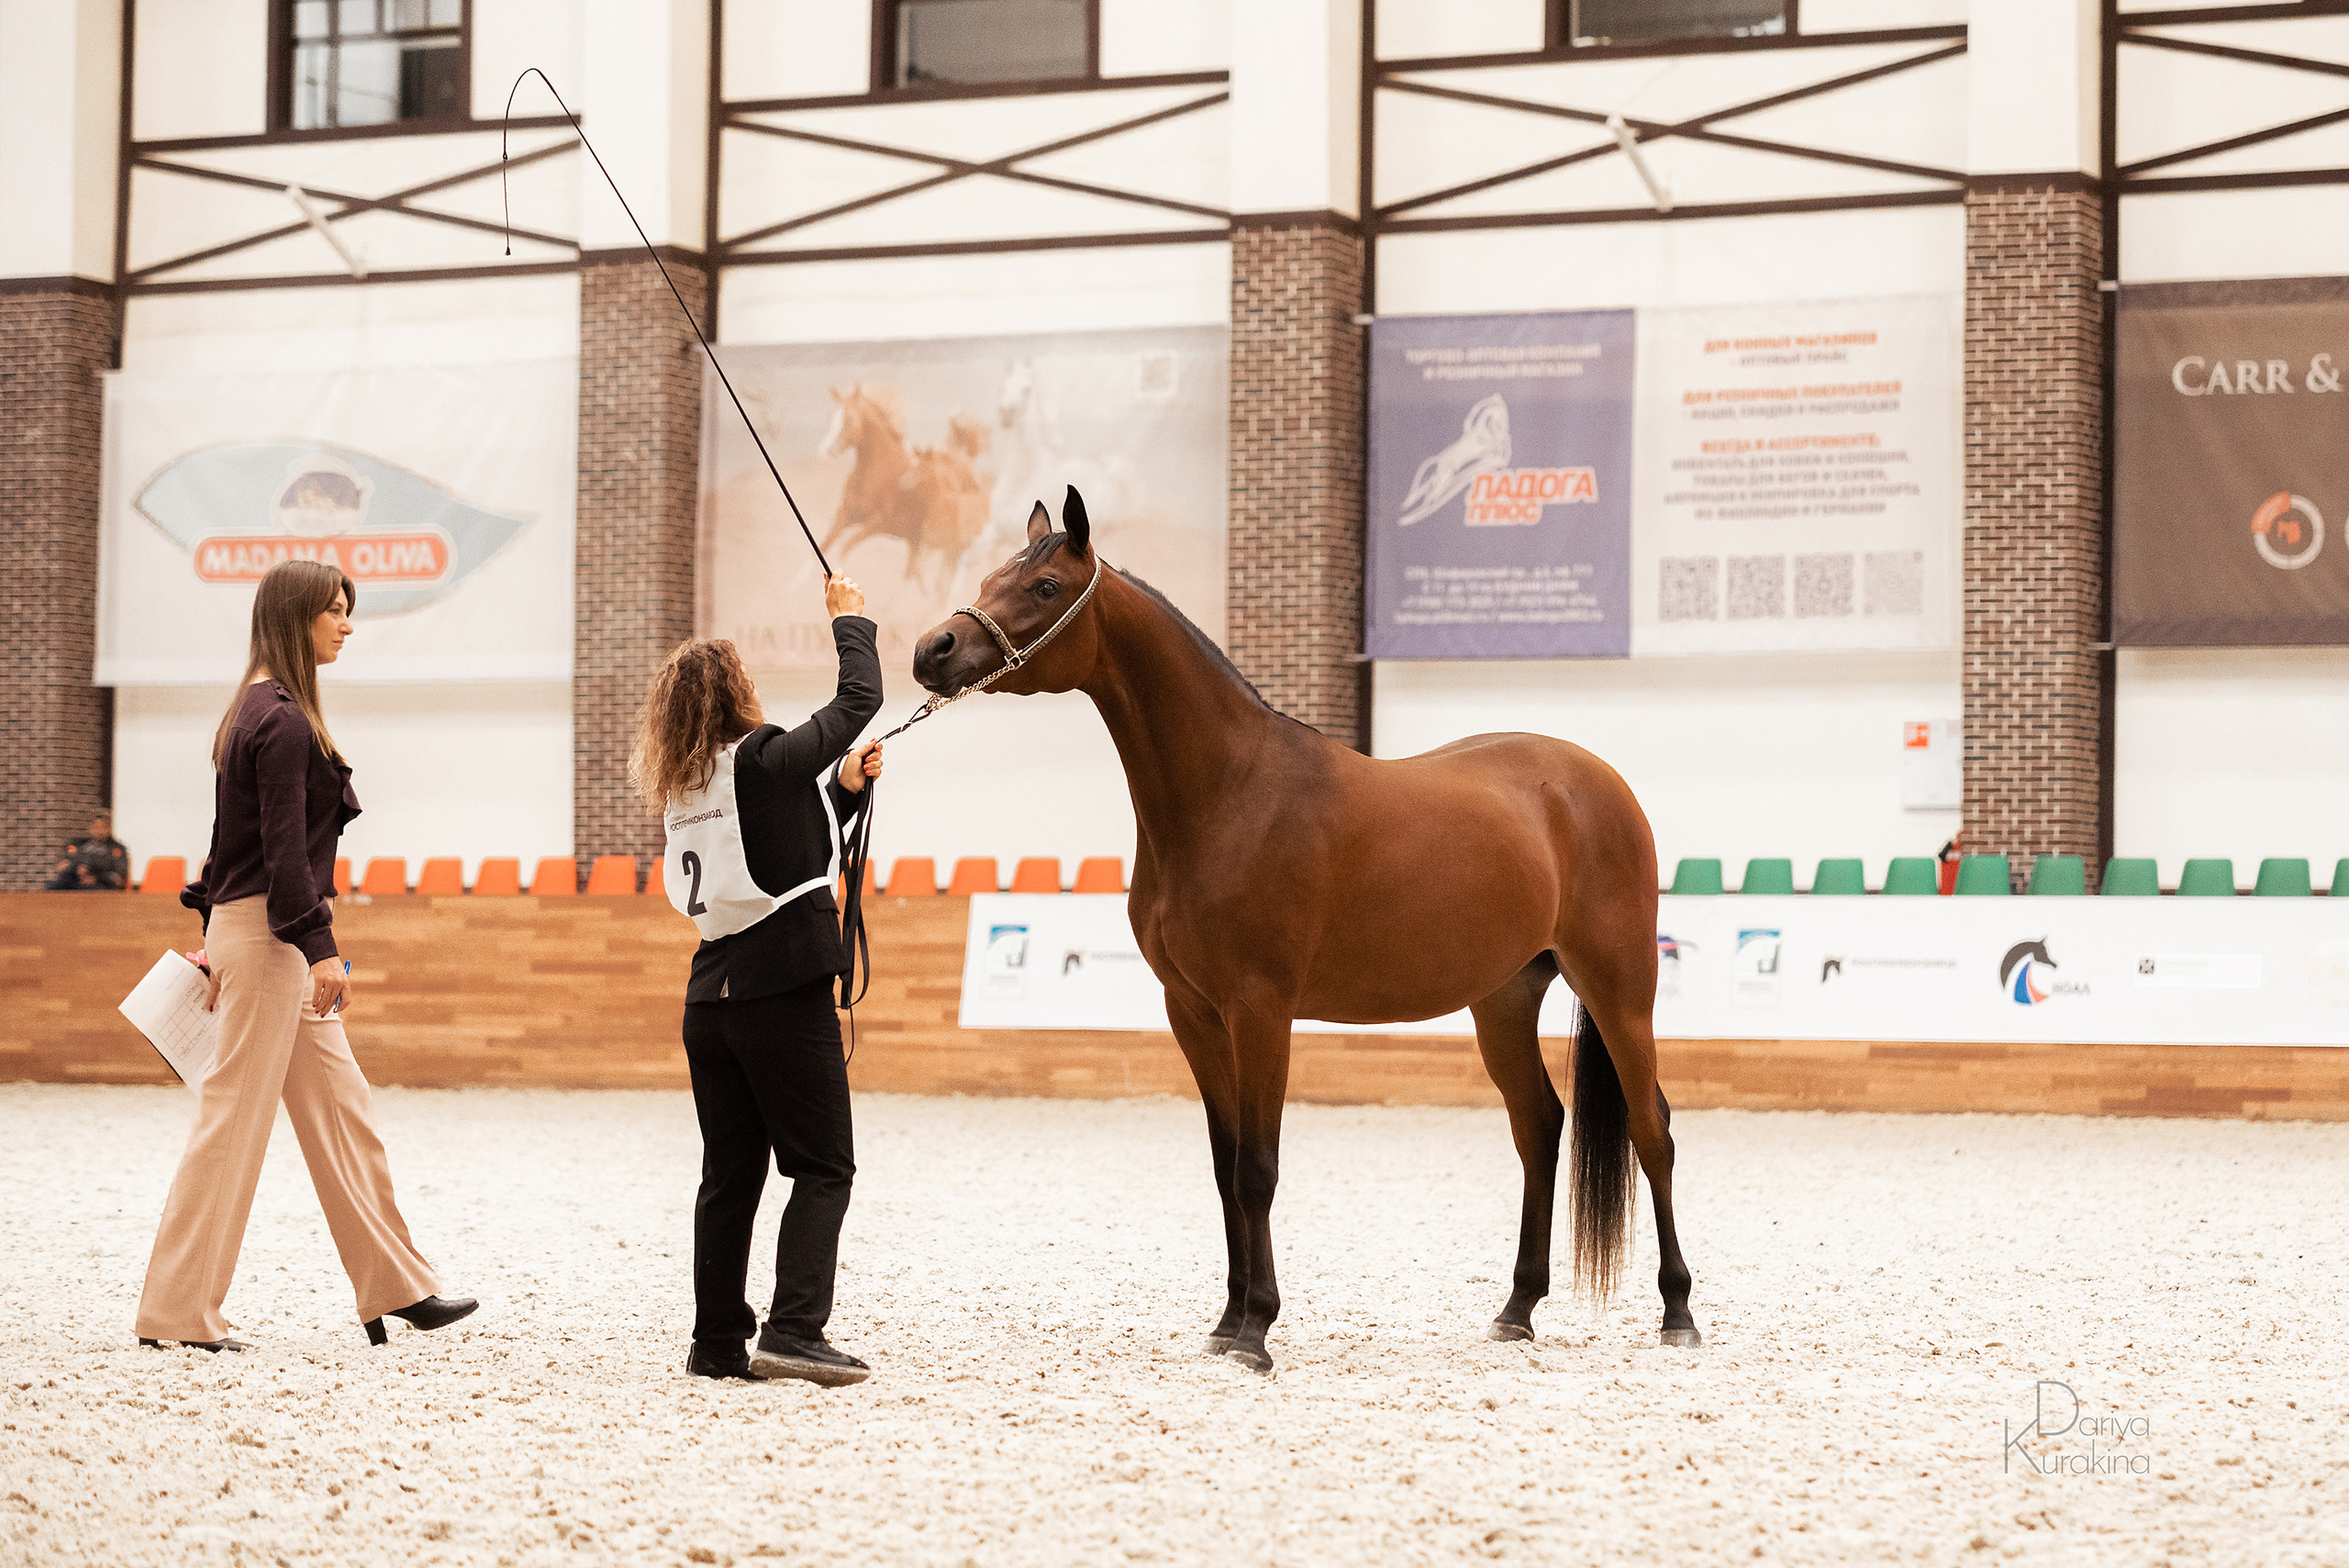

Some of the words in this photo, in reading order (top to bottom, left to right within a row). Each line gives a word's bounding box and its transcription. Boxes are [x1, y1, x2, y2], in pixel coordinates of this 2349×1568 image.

[2305, 353, 2344, 395] &
[1472, 472, 1593, 499] ЛАДОГА
[351, 539, 438, 574] OLIVA
[682, 851, 707, 917] 2
